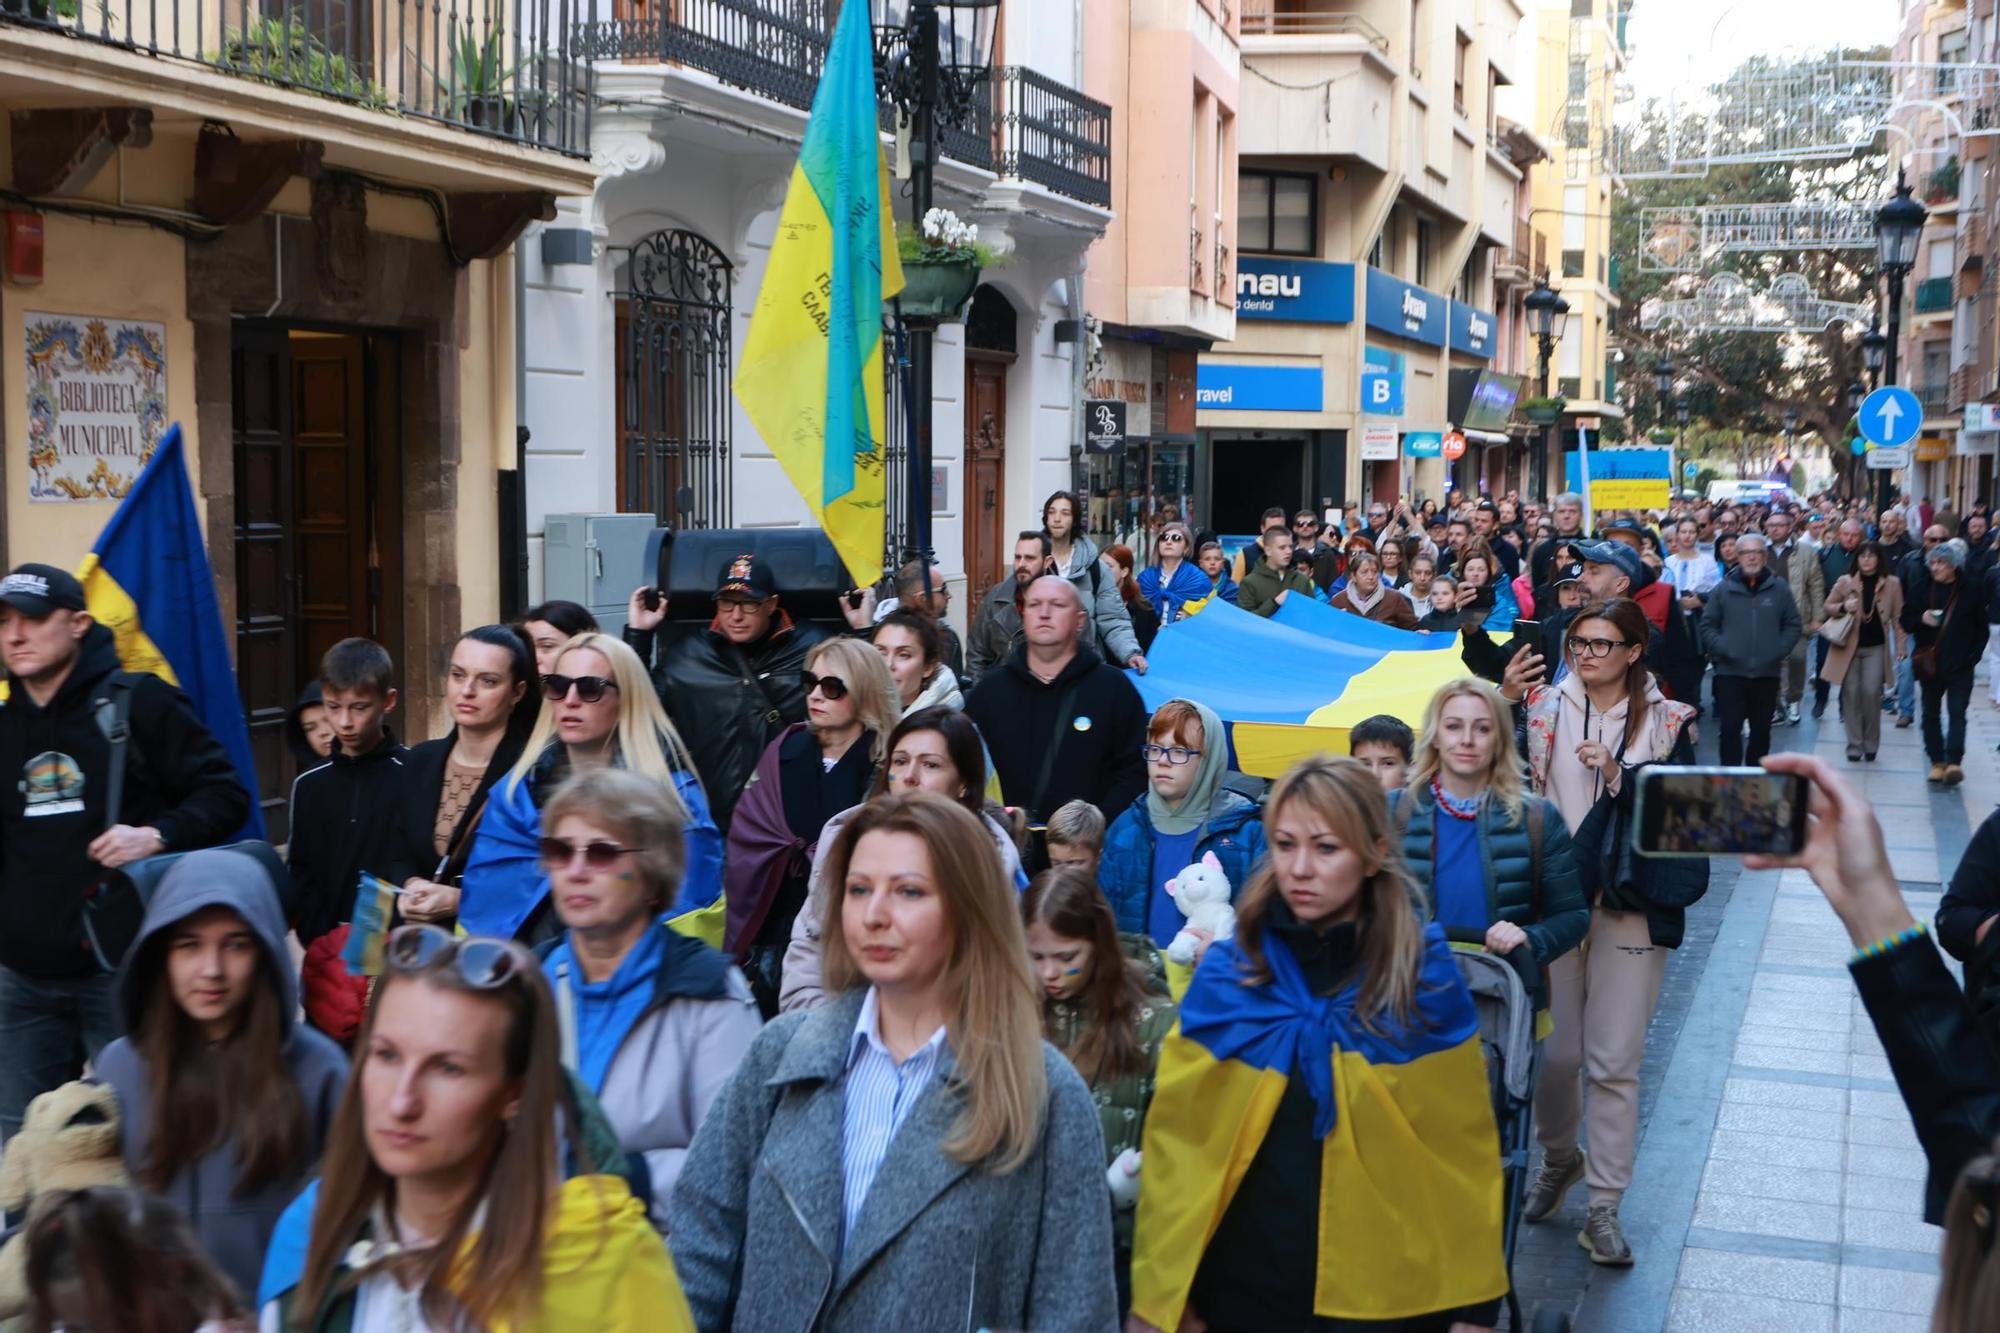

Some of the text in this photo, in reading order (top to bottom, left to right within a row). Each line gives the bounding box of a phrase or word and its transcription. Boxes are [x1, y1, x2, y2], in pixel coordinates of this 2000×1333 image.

[1237, 272, 1300, 297] nau
[1243, 299, 1274, 311] dental
[59, 381, 138, 414] BIBLIOTECA
[1197, 386, 1232, 403] ravel
[1373, 379, 1390, 403] B
[59, 424, 138, 456] MUNICIPAL
